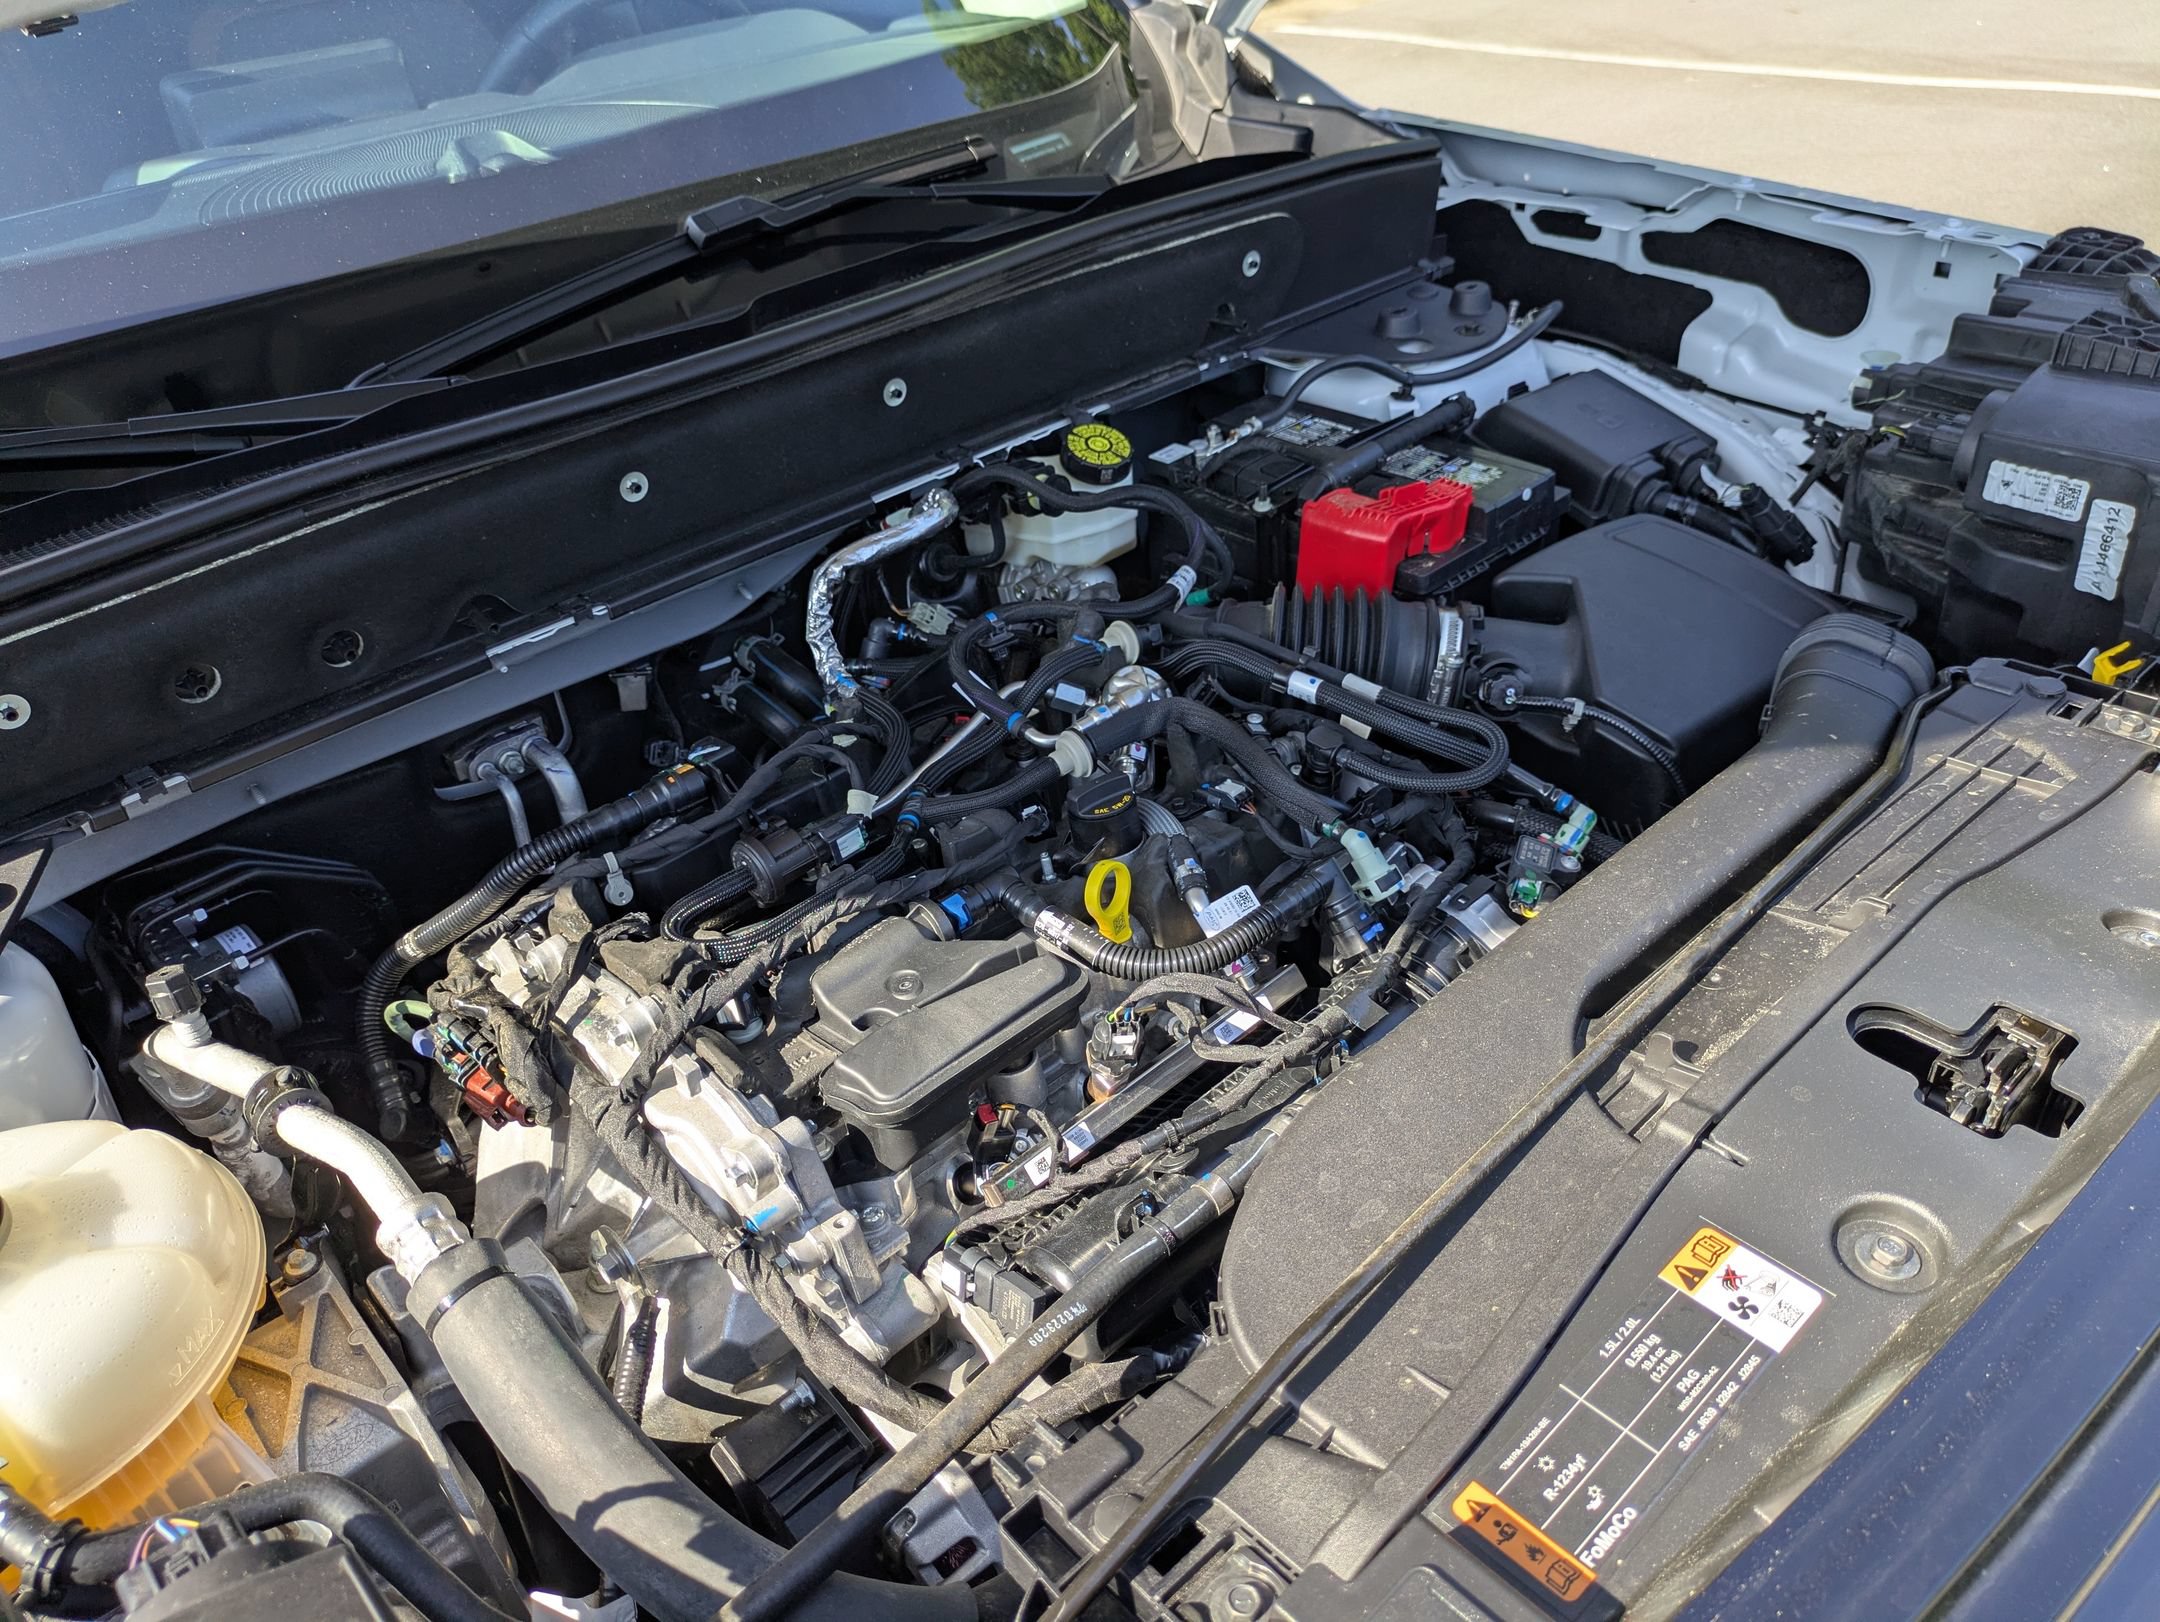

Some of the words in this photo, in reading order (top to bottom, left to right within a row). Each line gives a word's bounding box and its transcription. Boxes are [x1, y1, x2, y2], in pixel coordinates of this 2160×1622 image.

[176, 1306, 221, 1364] MAX
[1599, 1340, 1621, 1359] 1.5L
[1618, 1317, 1642, 1338] 2.0L
[1624, 1343, 1650, 1368] 0.550
[1642, 1333, 1662, 1347] kg
[1641, 1354, 1659, 1371] 19.4
[1654, 1346, 1667, 1358] oz
[1650, 1362, 1671, 1383] (1.21
[1663, 1349, 1683, 1366] lbs)
[1676, 1369, 1701, 1393] PAG
[1678, 1428, 1701, 1451] SAE
[1697, 1407, 1718, 1430] J639
[1716, 1381, 1740, 1408] J2842
[1738, 1354, 1761, 1381] J2845
[1542, 1453, 1587, 1501] R-1234yf
[1579, 1506, 1637, 1569] FoMoCo
